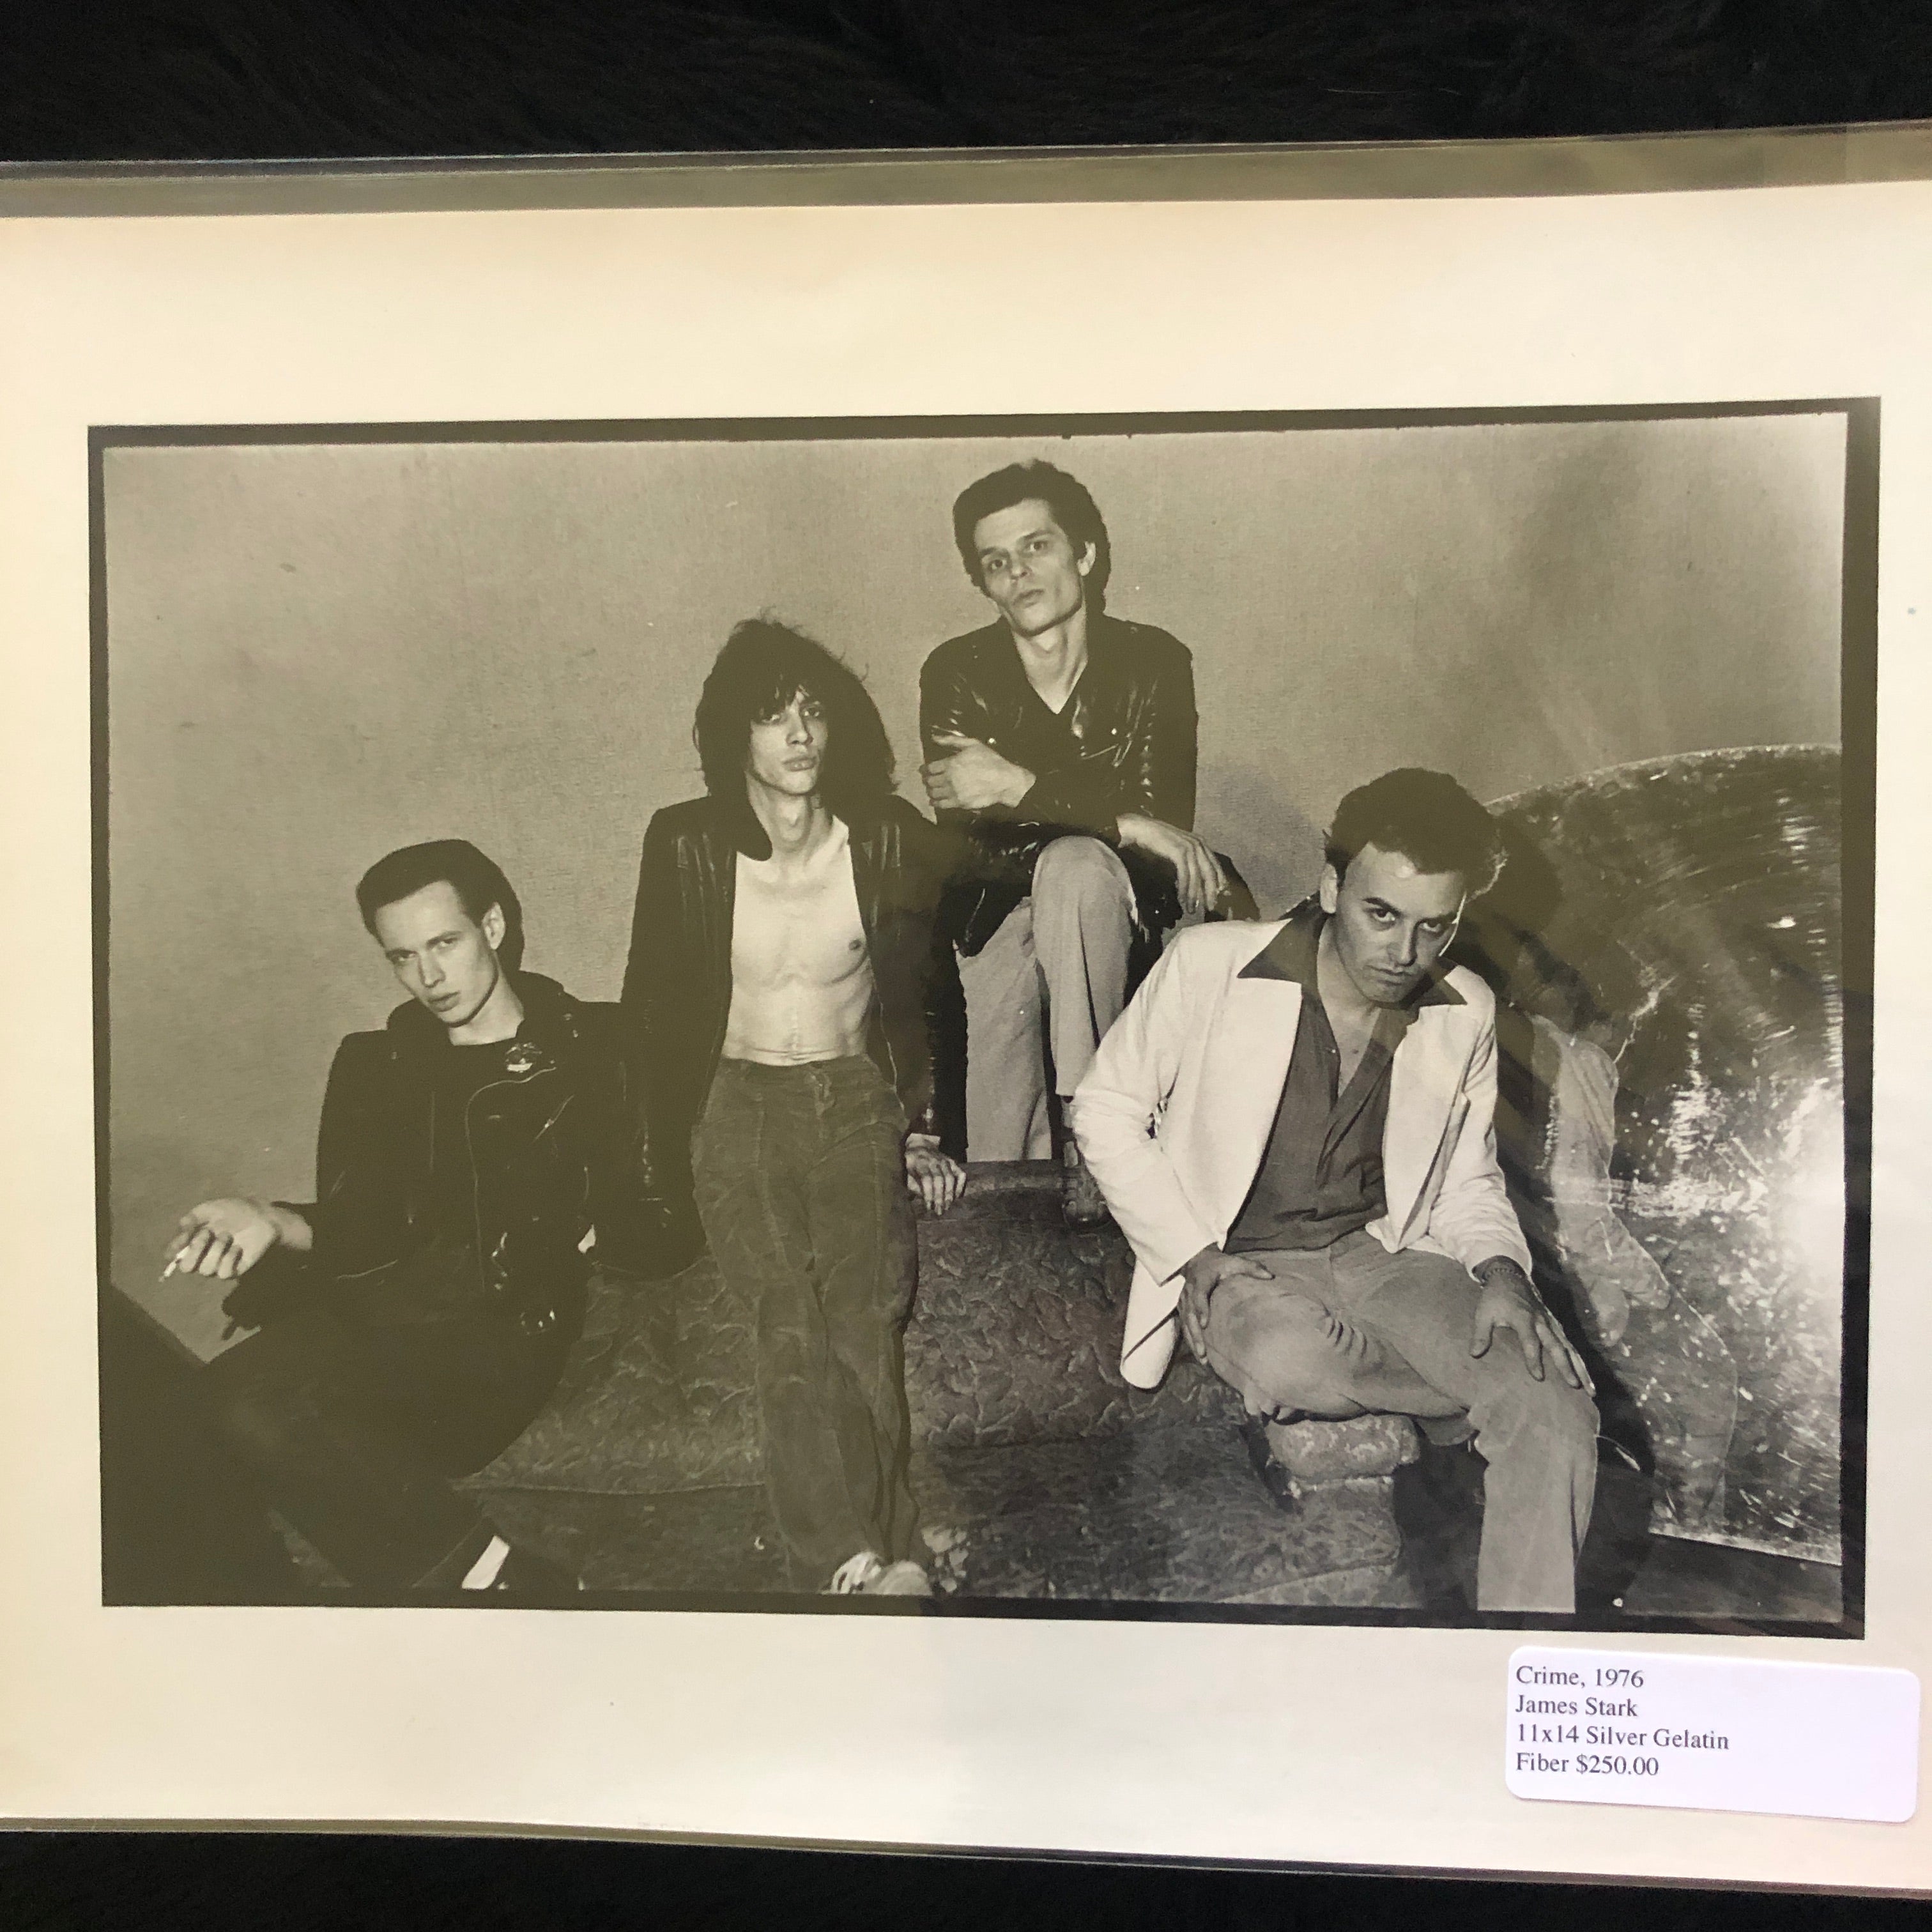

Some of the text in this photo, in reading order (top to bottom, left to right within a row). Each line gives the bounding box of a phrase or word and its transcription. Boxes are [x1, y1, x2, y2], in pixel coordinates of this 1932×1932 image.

[1516, 1666, 1644, 1687] Crime, 1976
[1515, 1694, 1637, 1717] James Stark
[1517, 1723, 1729, 1750] 11x14 Silver Gelatin
[1516, 1752, 1659, 1775] Fiber $250.00
